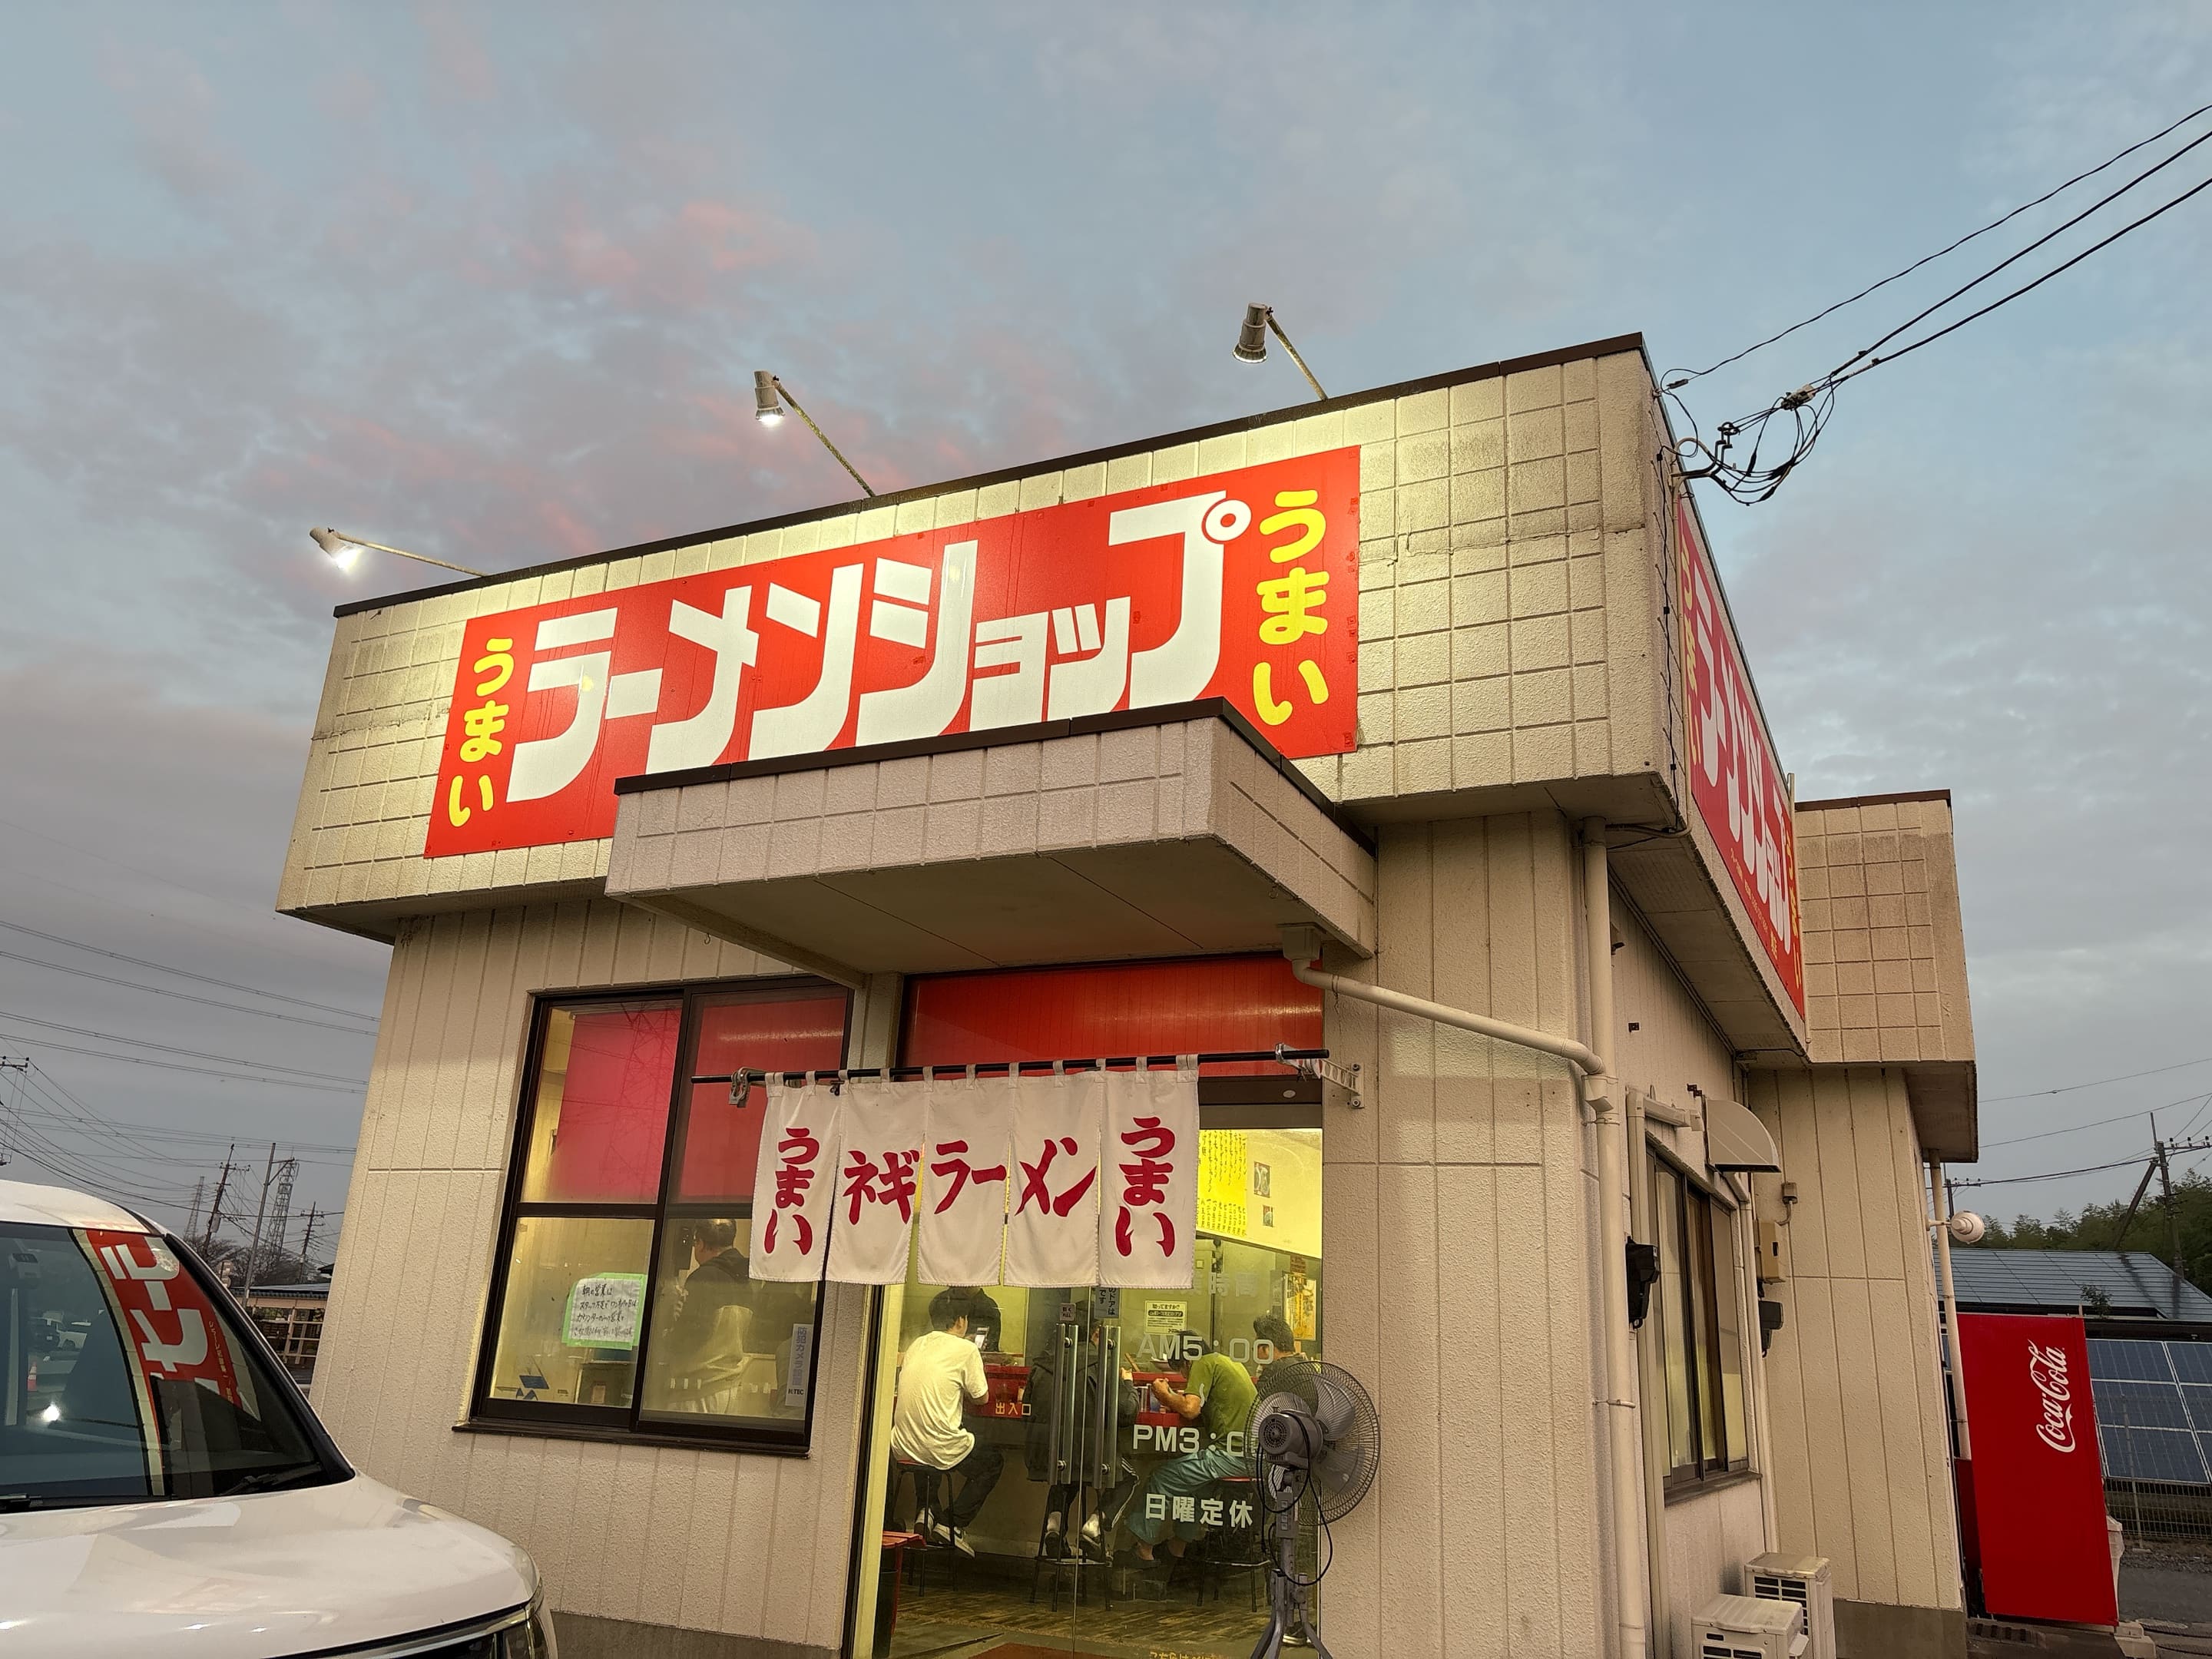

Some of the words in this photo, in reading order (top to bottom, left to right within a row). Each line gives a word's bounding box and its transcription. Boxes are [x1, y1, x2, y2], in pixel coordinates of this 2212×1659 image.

[506, 490, 1253, 803] ラーメンショップ
[1252, 489, 1330, 727] うまい
[447, 637, 515, 828] うまい
[1694, 561, 1791, 955] ラーメンショップ
[764, 1128, 820, 1256] うまい
[843, 1137, 1098, 1225] ネギラーメン
[1114, 1117, 1176, 1258] うまい
[995, 1402, 1031, 1416] 出入口
[2027, 1339, 2076, 1453] Coca-Cola
[1145, 1492, 1253, 1528] 日曜定休
